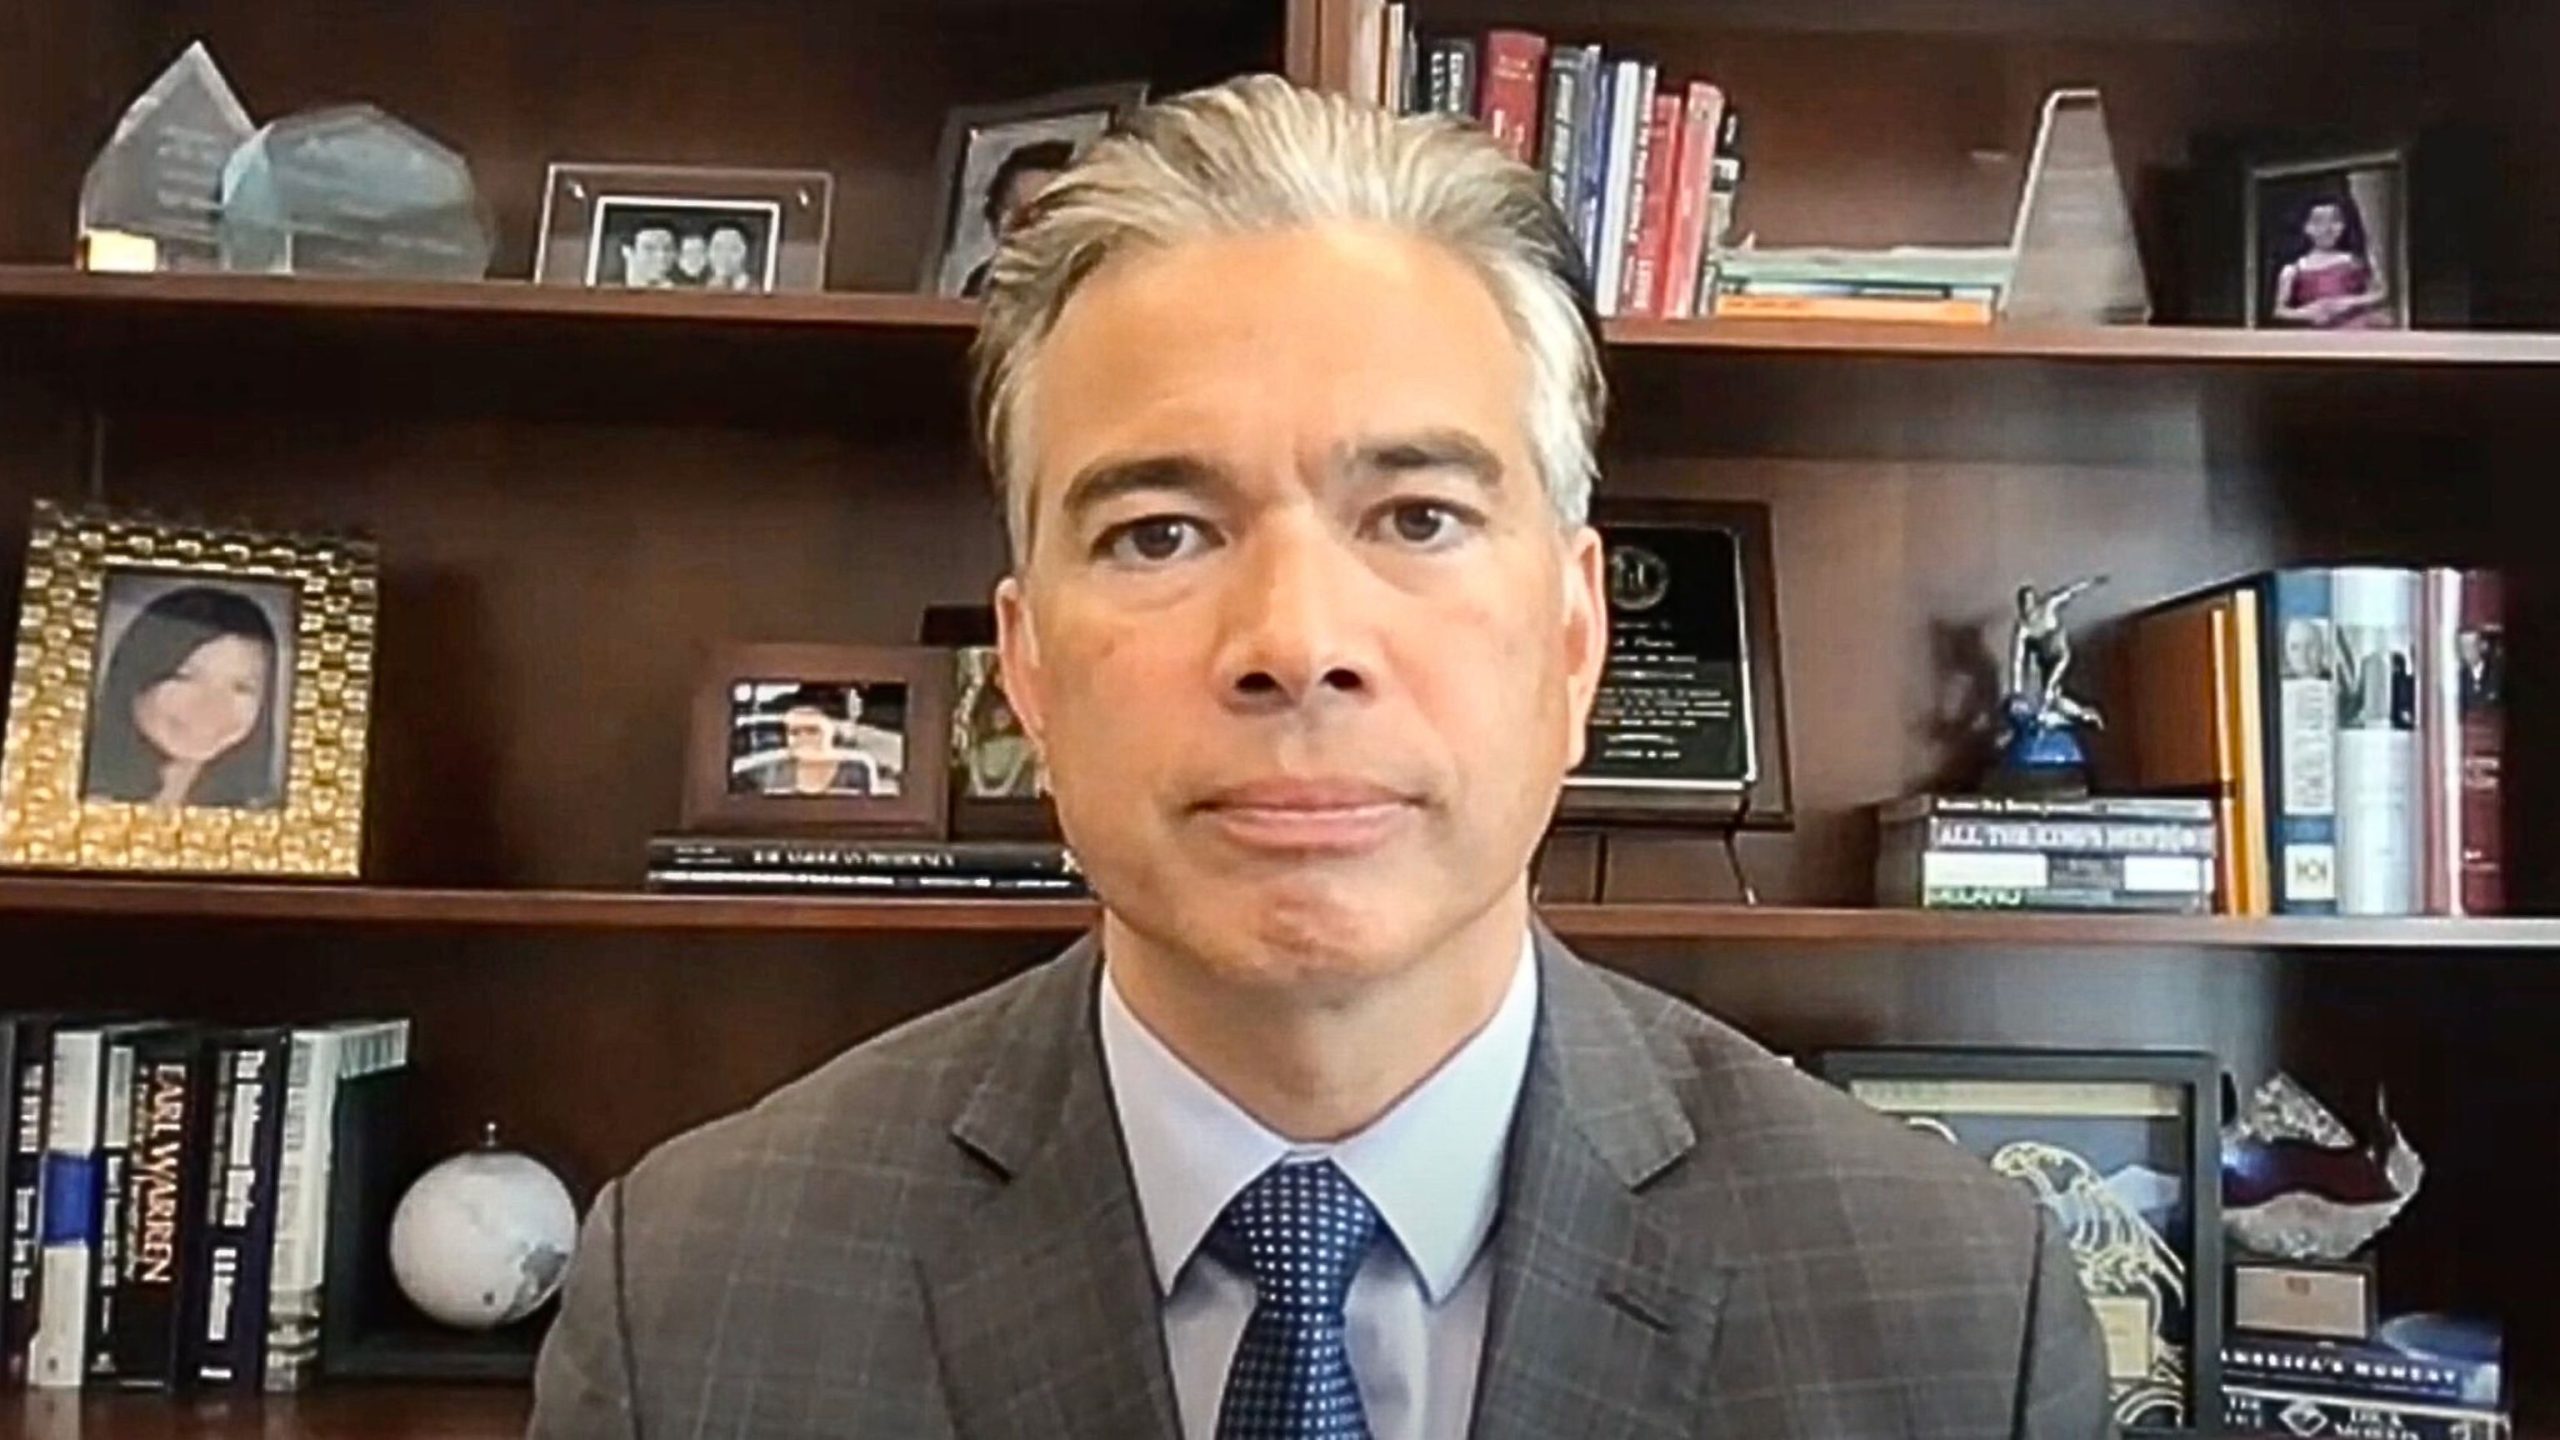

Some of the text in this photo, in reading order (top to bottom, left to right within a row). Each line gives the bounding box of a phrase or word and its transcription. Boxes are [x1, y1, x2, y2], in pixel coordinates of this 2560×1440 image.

[1939, 822, 1983, 847] ALL
[1986, 823, 2029, 847] THE
[139, 1063, 187, 1283] EARL WARREN
[2354, 1360, 2457, 1384] MOMENT
